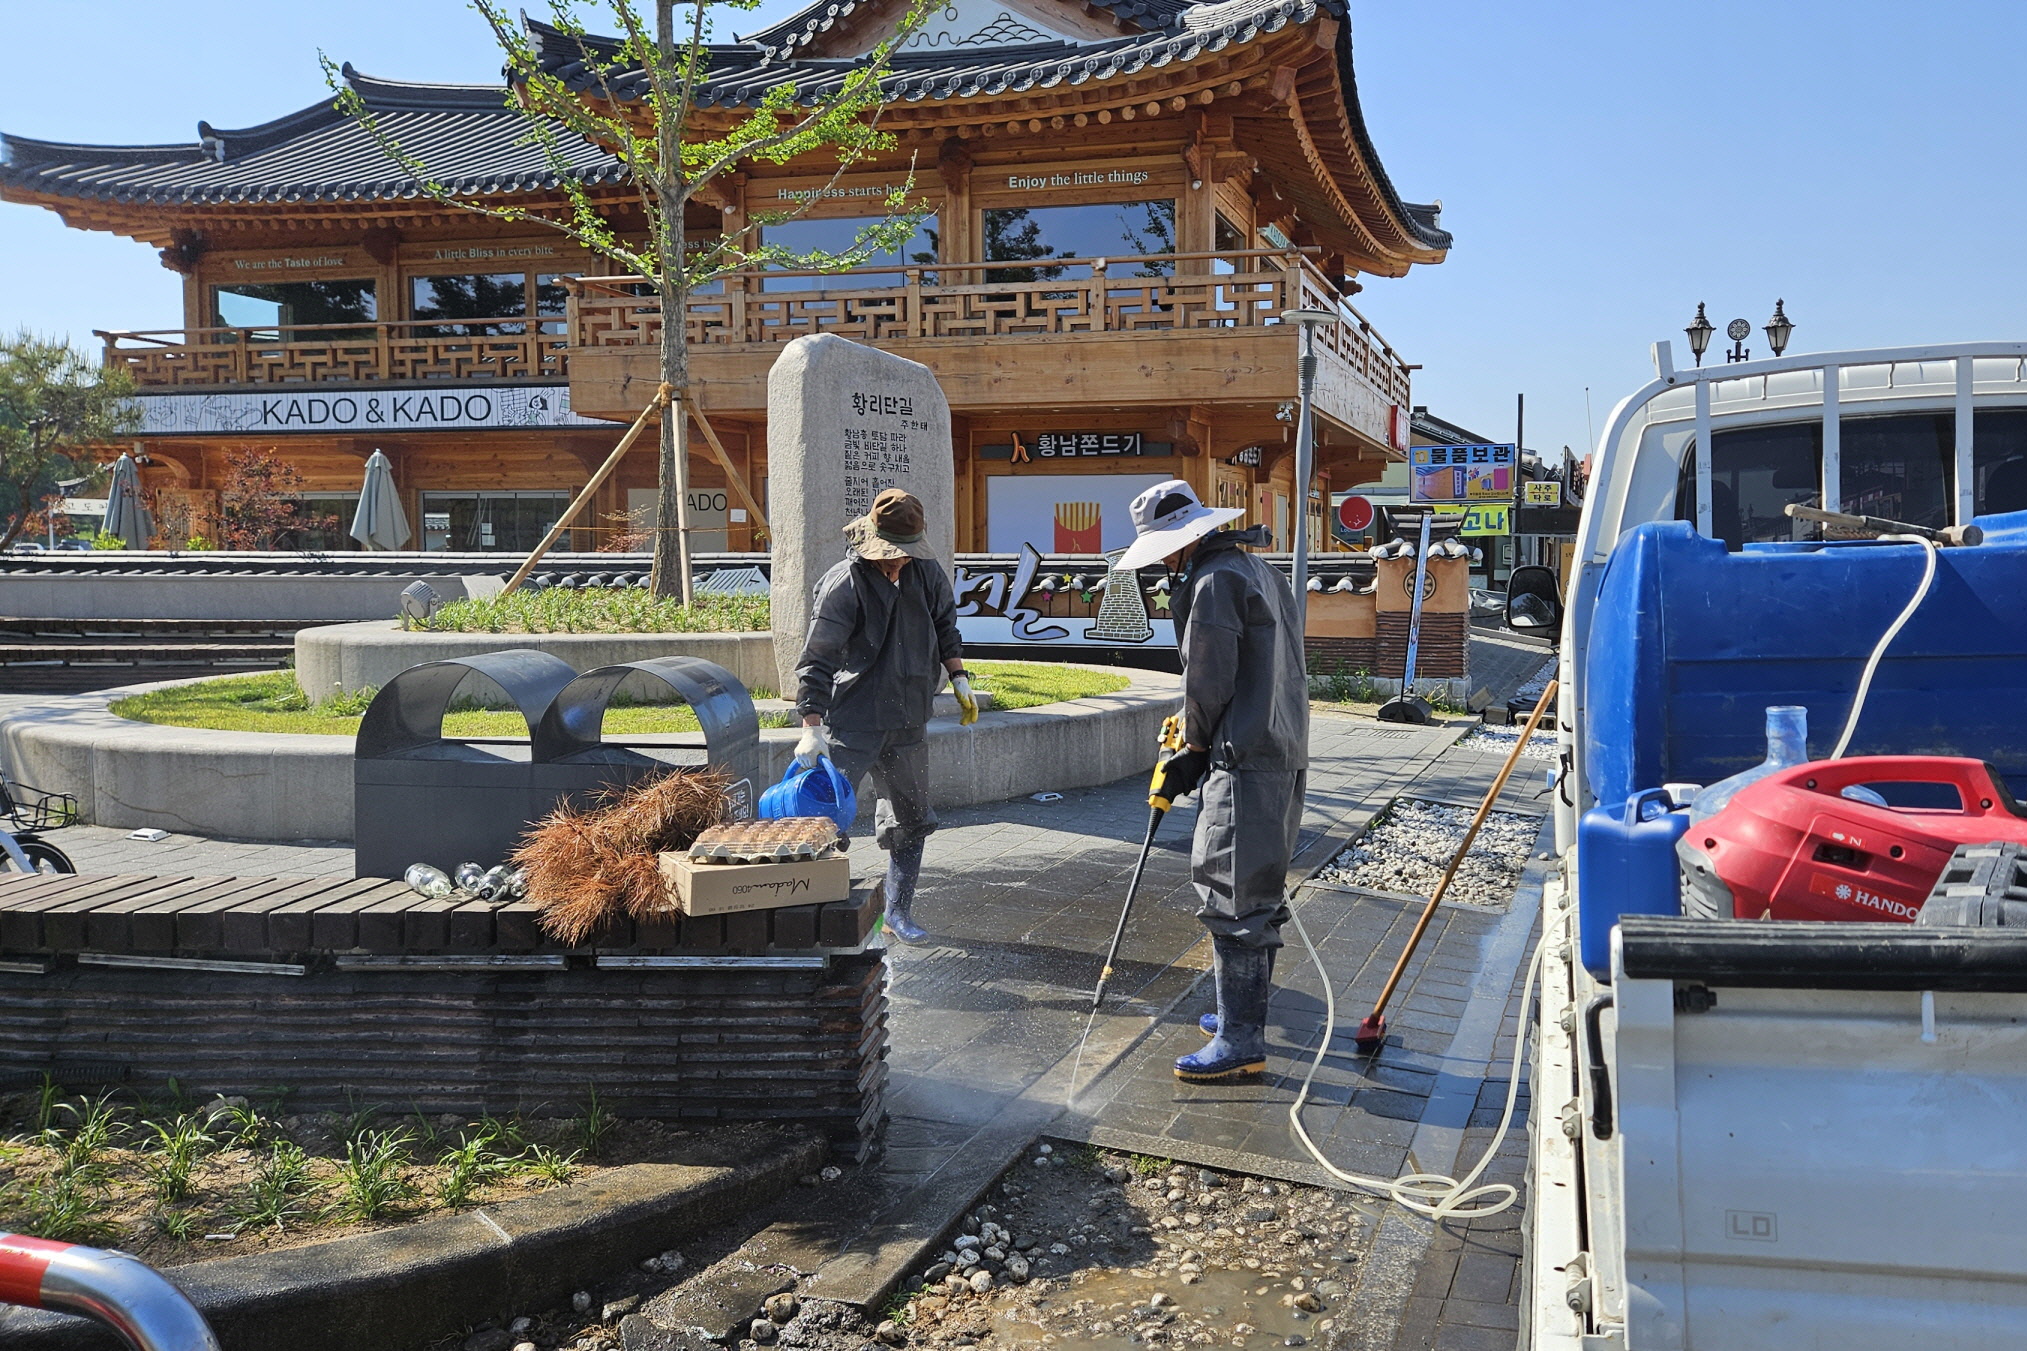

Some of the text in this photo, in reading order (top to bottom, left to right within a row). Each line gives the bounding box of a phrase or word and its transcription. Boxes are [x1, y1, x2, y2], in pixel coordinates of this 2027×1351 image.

[1008, 169, 1149, 190] Enjoy the little things
[848, 185, 882, 197] starts
[434, 245, 554, 259] A little Bliss in every bite
[234, 256, 344, 270] We are the Taste of love
[262, 395, 492, 426] KADO & KADO
[851, 392, 914, 416] 황리단길
[890, 432, 907, 444] 따라
[1037, 432, 1145, 458] 황남쫀드기
[864, 451, 880, 462] 커피
[1431, 446, 1511, 464] 물품보관
[688, 493, 728, 512] ADO
